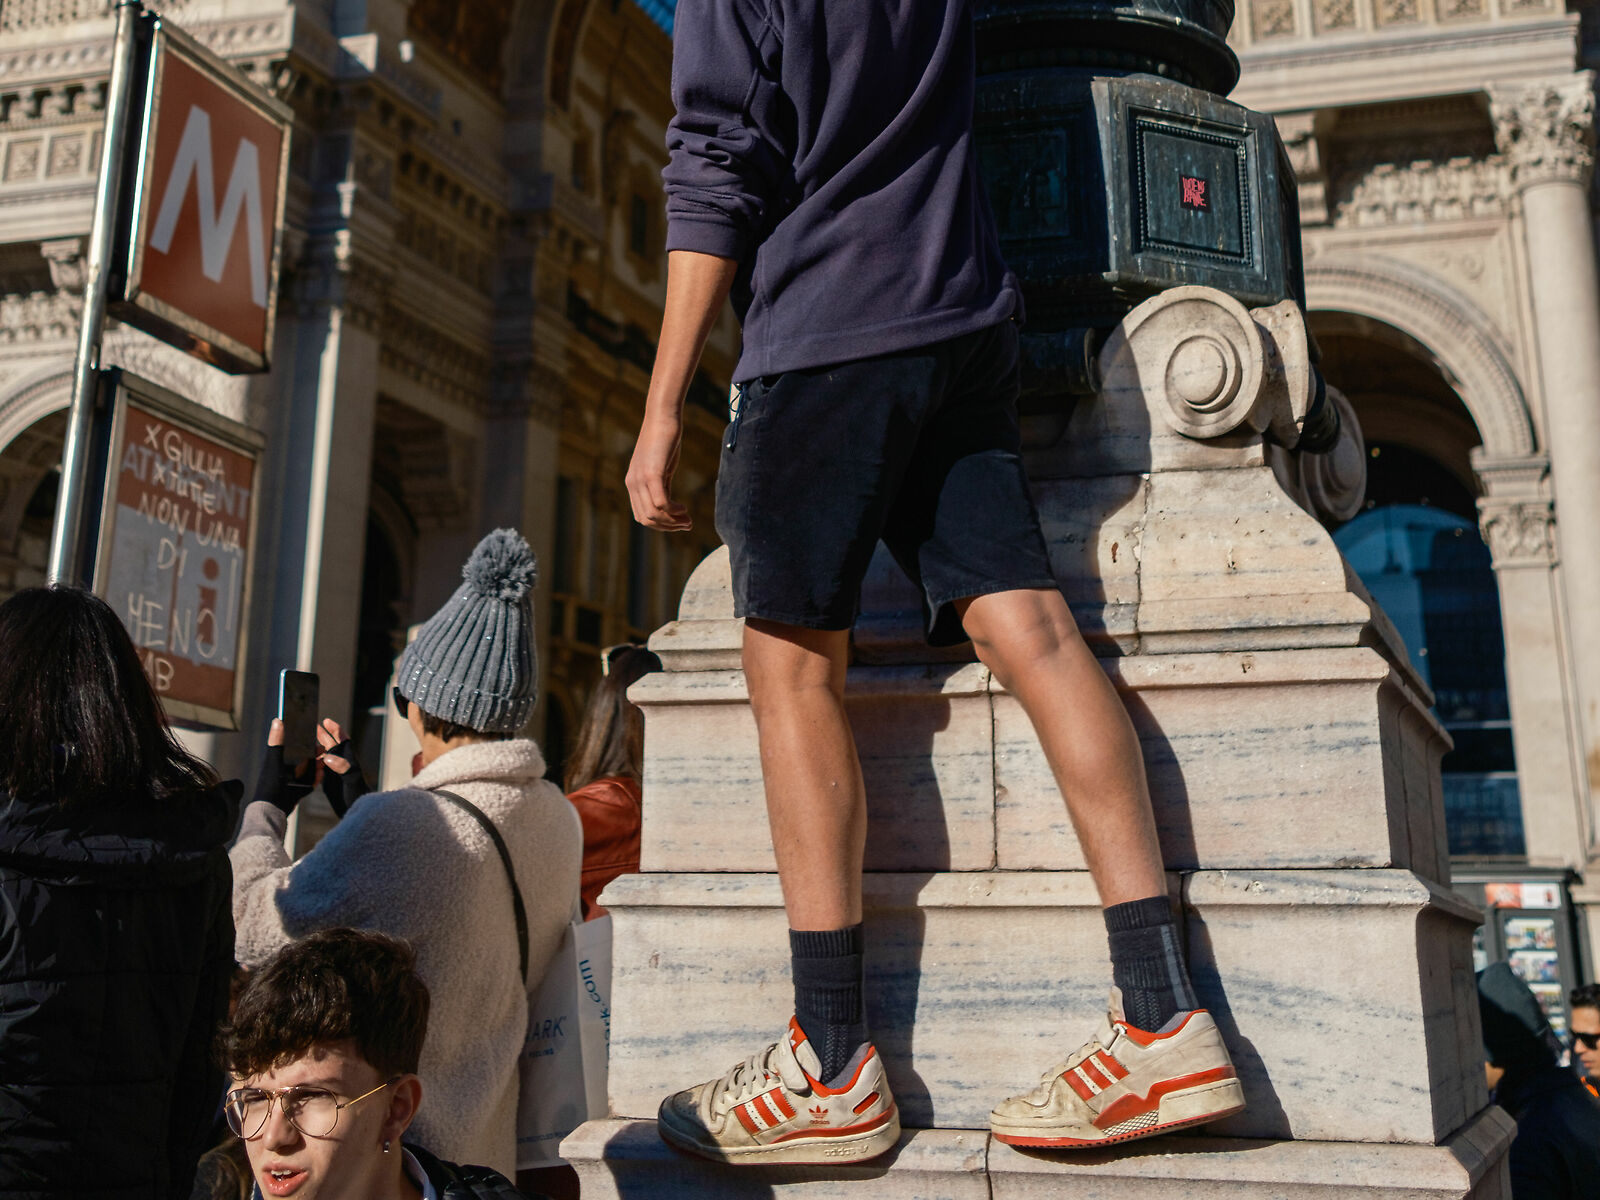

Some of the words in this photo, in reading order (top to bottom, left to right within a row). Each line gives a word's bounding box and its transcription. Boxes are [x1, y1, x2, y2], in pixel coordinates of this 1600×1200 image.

[150, 105, 268, 309] M
[136, 491, 190, 535] NON
[195, 511, 242, 556] UNA
[157, 537, 188, 577] DI
